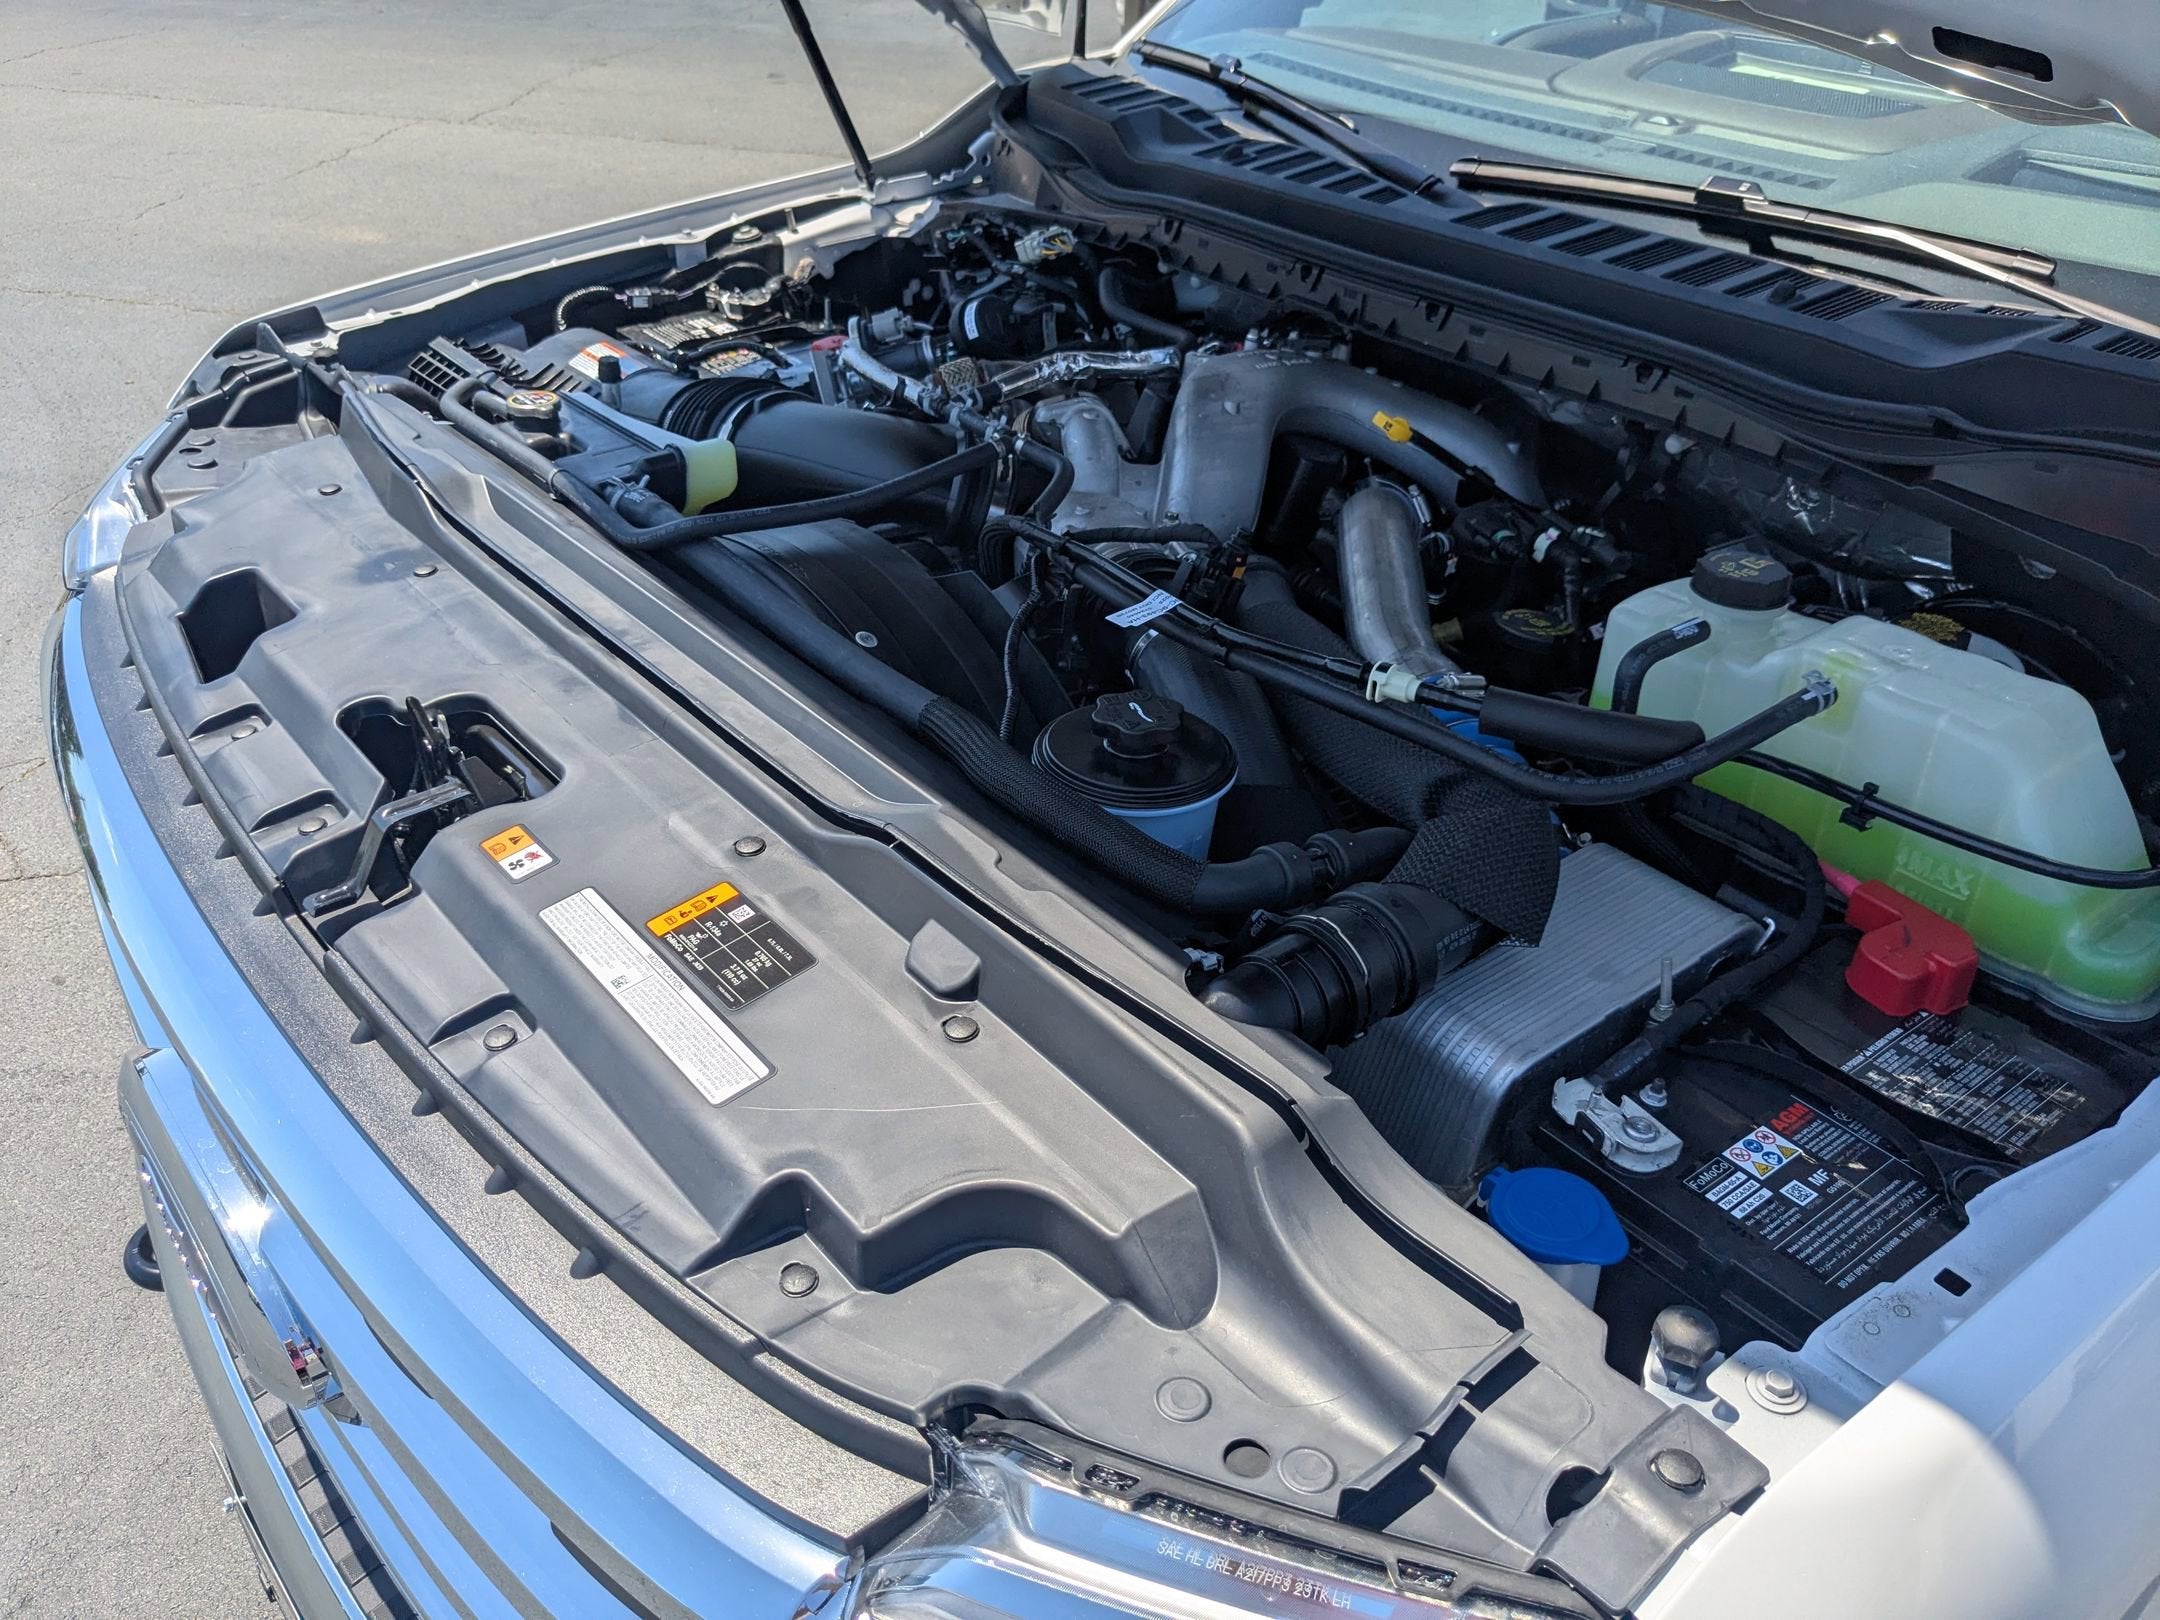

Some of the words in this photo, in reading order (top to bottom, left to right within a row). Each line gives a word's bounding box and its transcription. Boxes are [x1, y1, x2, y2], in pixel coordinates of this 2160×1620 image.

[705, 921, 722, 937] R-134a
[664, 933, 684, 952] FoMoCo
[687, 934, 700, 945] PAG
[646, 953, 686, 992] MODIFICATION
[1771, 1103, 1809, 1131] AGM
[1689, 1159, 1729, 1191] FoMoCo
[1808, 1169, 1829, 1186] MF
[1731, 1182, 1757, 1201] CCA/SAE
[1745, 1201, 1756, 1209] Ah
[1837, 1280, 1848, 1289] DO
[1844, 1272, 1857, 1283] NOT
[1873, 1249, 1886, 1260] PAS
[1156, 1539, 1185, 1561] SAE
[1185, 1547, 1205, 1567] HL
[1205, 1553, 1234, 1575] DRL
[1331, 1588, 1353, 1610] LH
